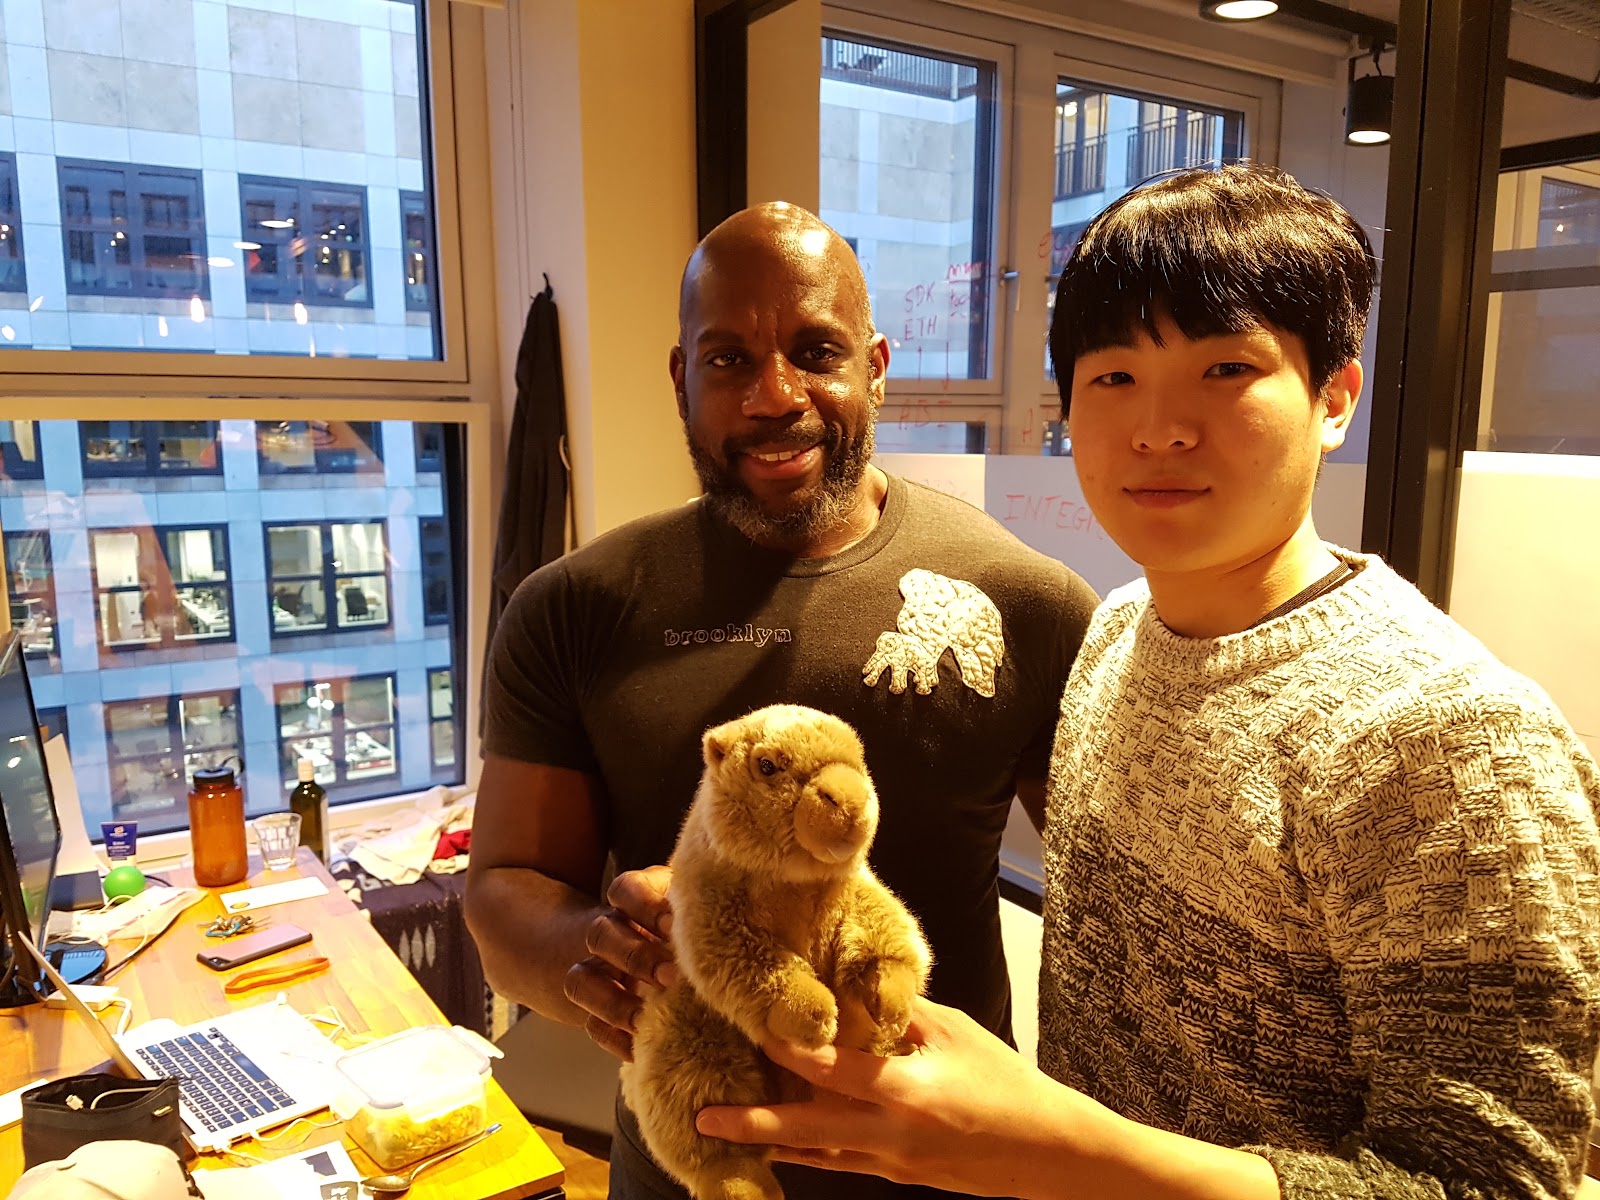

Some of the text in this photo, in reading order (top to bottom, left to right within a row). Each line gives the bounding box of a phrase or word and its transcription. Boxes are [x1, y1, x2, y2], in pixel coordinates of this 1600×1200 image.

[904, 281, 935, 313] SDK
[905, 315, 937, 341] ETH
[664, 623, 792, 648] brooklyn
